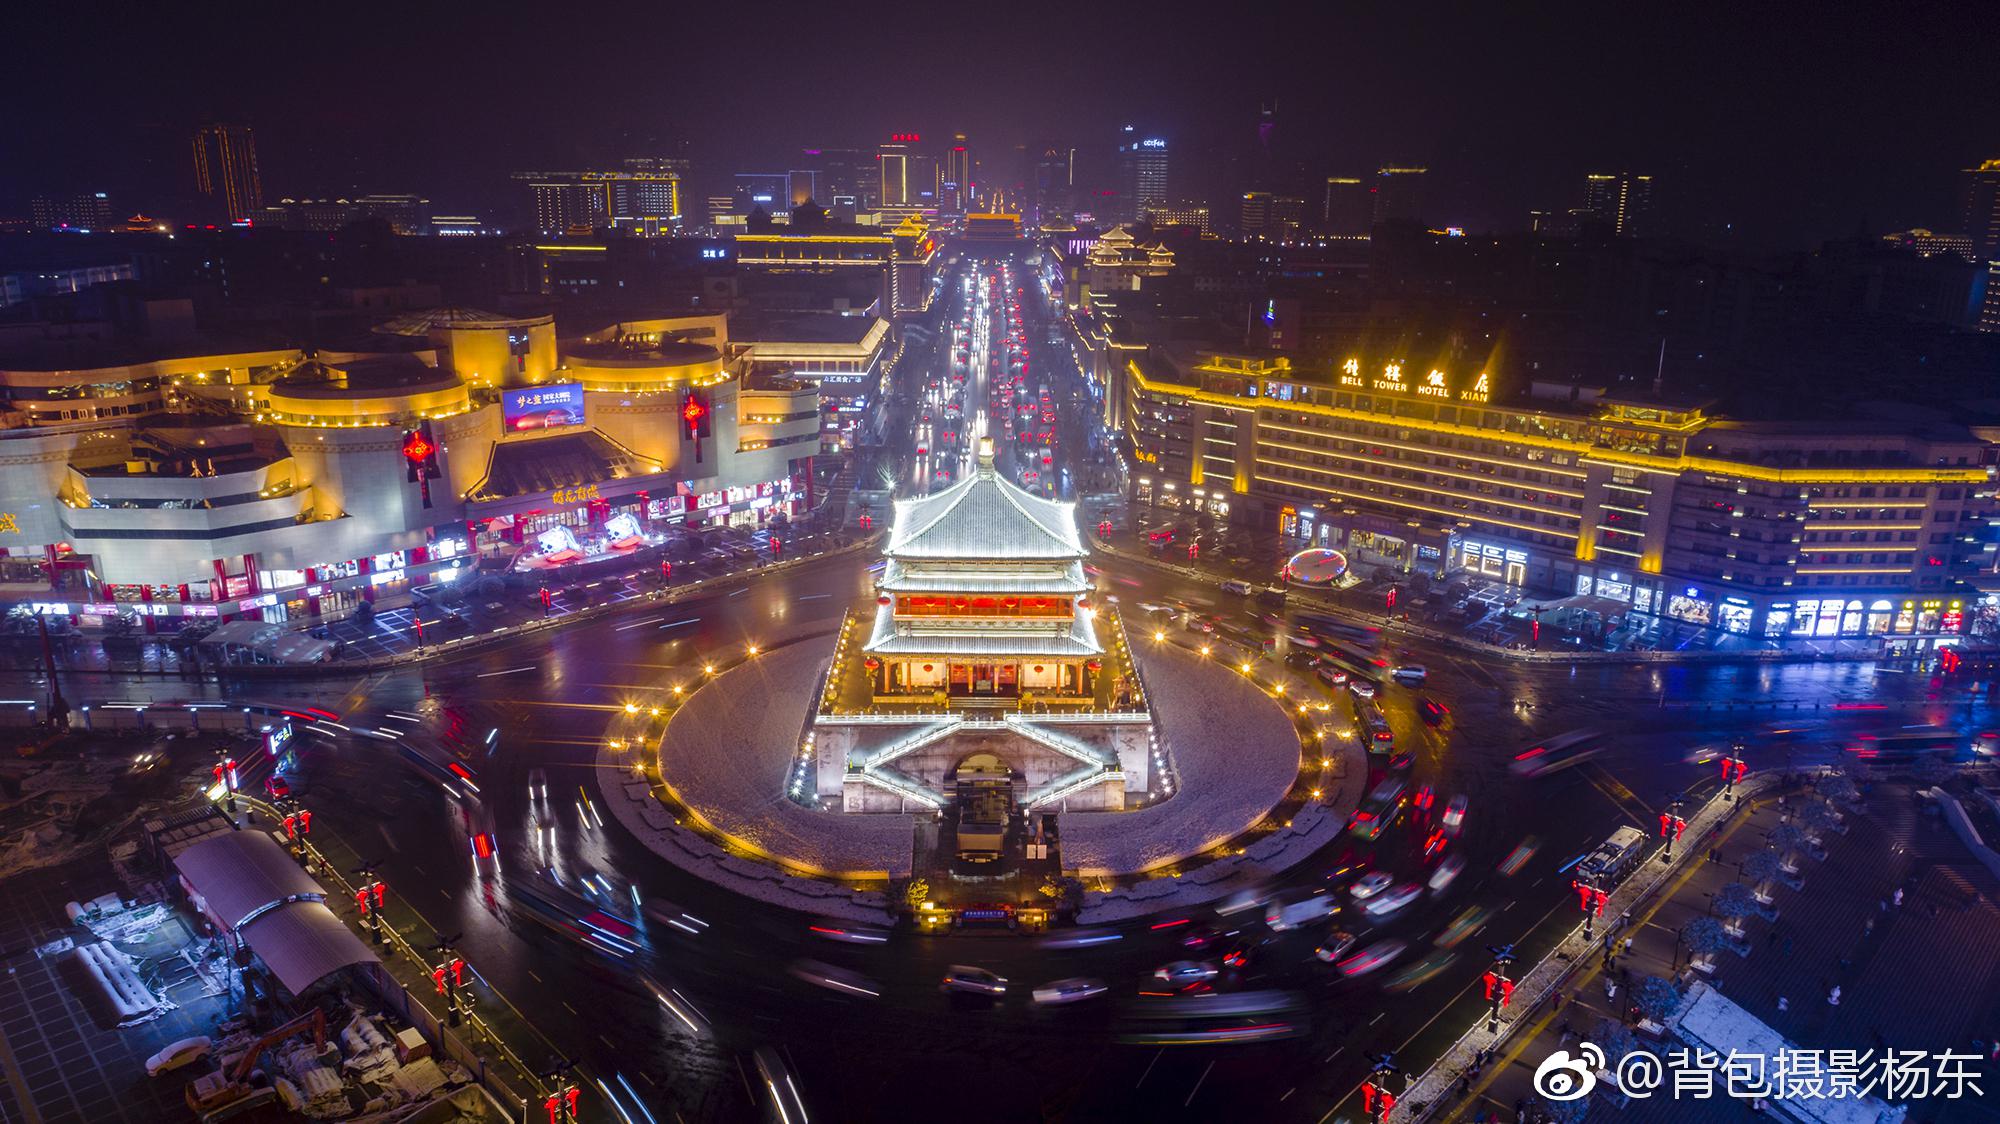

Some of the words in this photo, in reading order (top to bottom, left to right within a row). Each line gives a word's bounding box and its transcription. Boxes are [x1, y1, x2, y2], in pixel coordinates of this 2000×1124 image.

[1341, 375, 1363, 387] BELL
[1373, 379, 1407, 392] TOWER
[1418, 385, 1450, 398] HOTEL
[1460, 389, 1489, 402] XIAN
